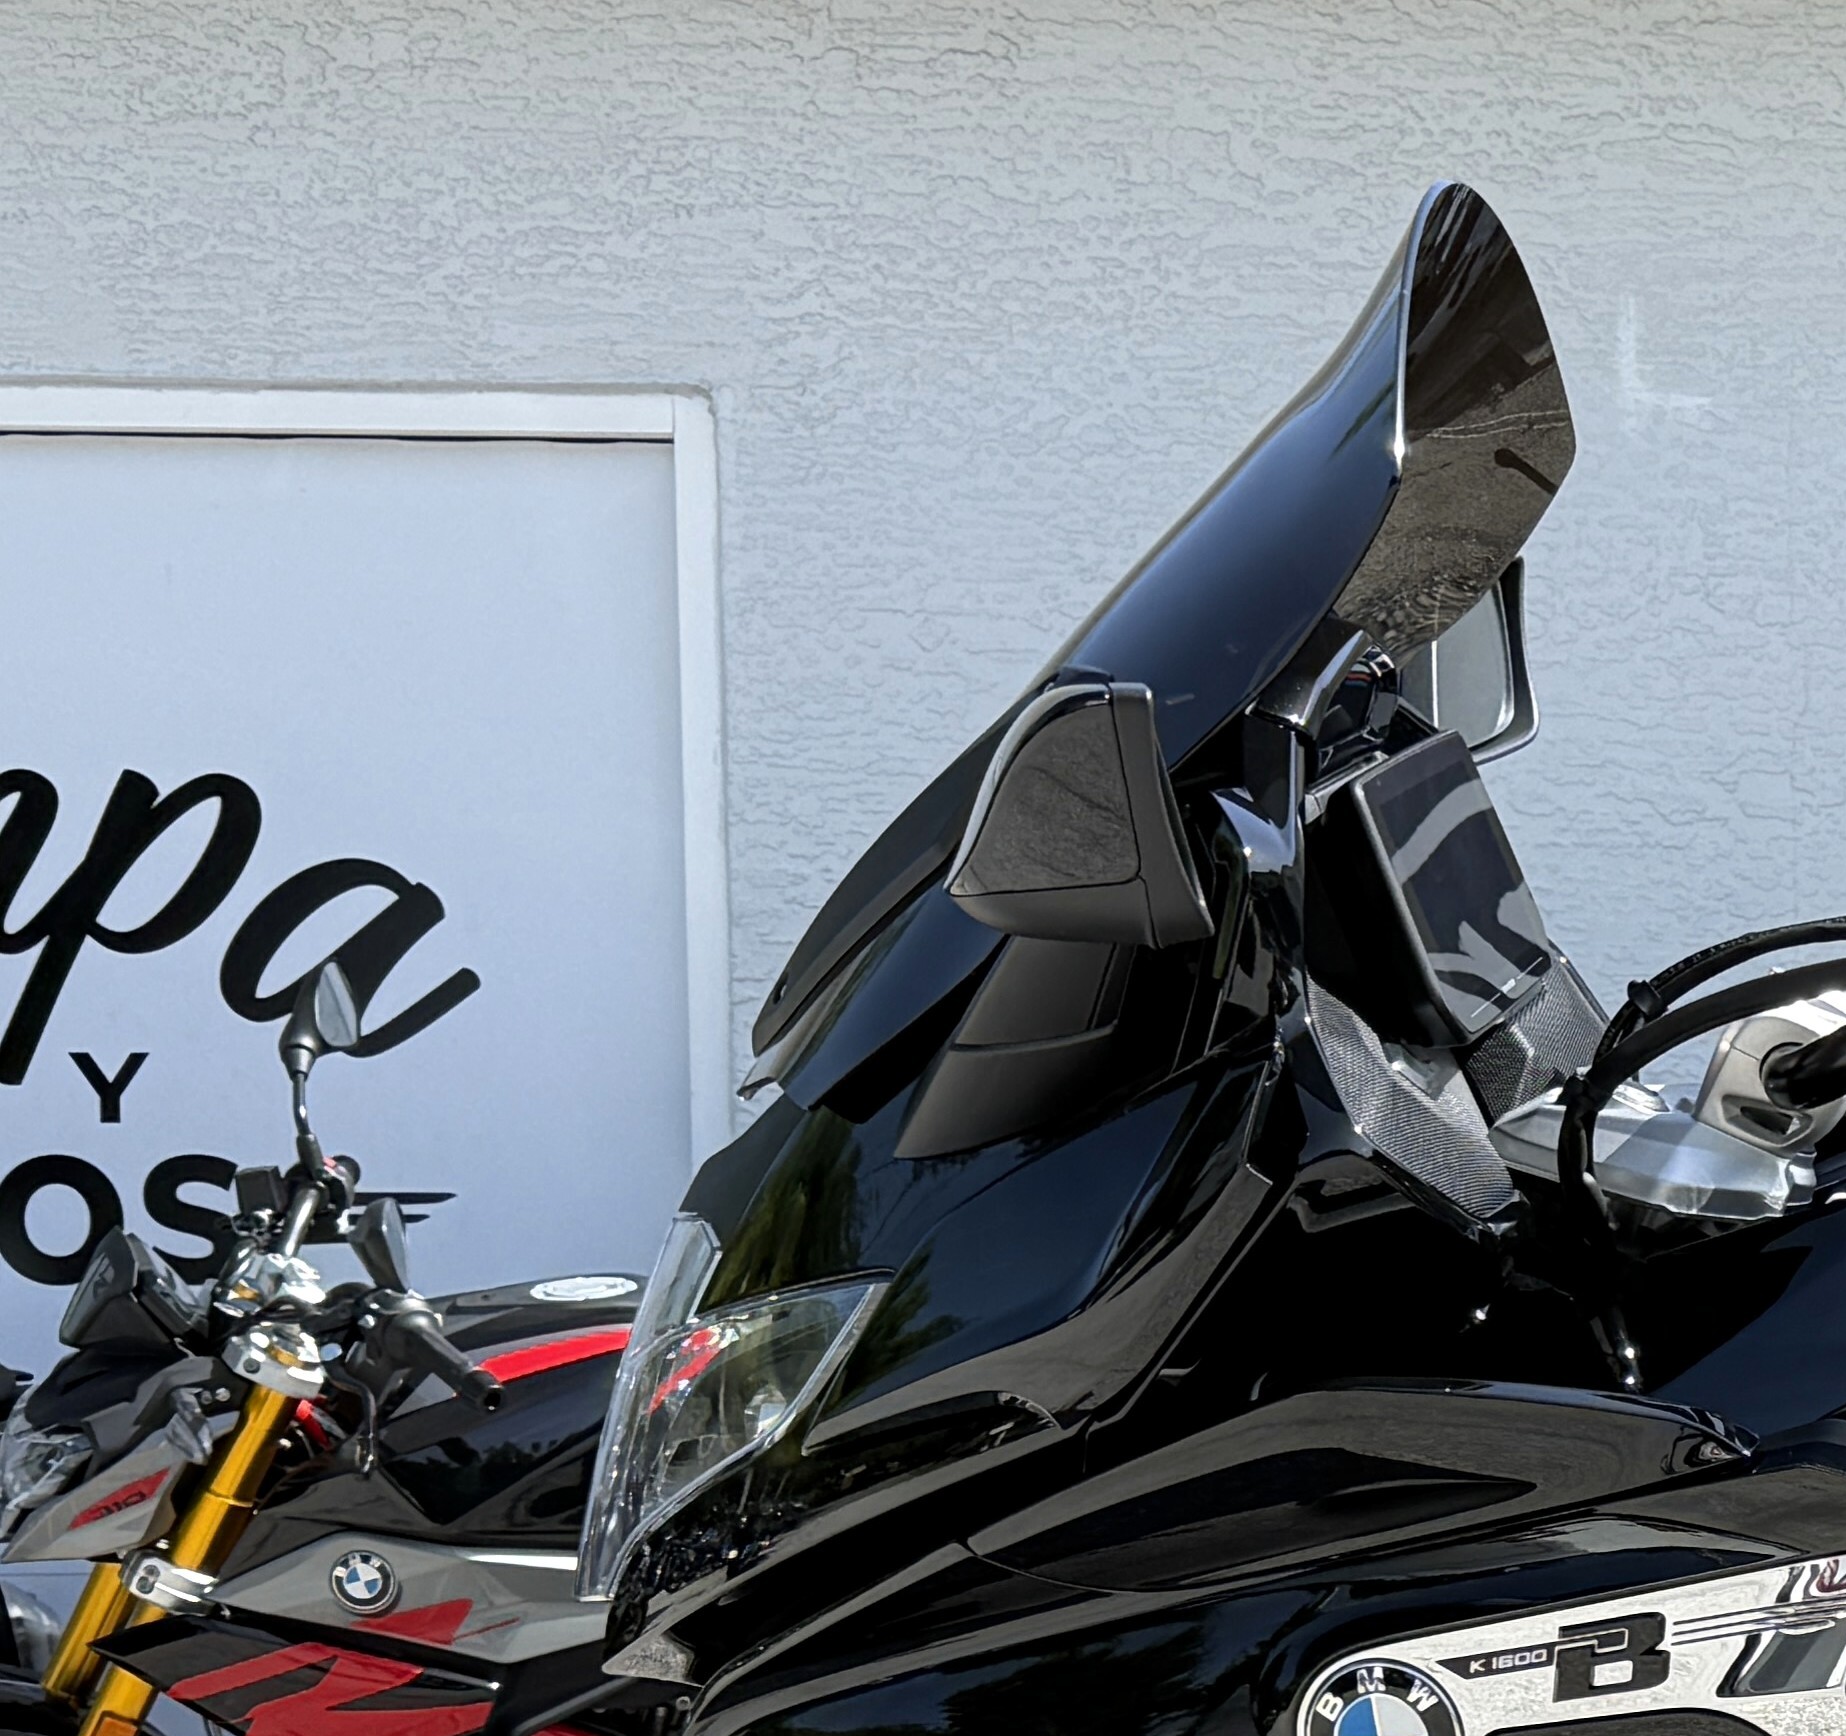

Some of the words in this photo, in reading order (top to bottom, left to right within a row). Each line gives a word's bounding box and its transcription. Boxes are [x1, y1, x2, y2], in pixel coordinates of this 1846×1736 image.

[1315, 1667, 1439, 1722] BMW
[1469, 1658, 1486, 1674] K
[1491, 1648, 1548, 1671] 1600
[1552, 1611, 1671, 1704] B
